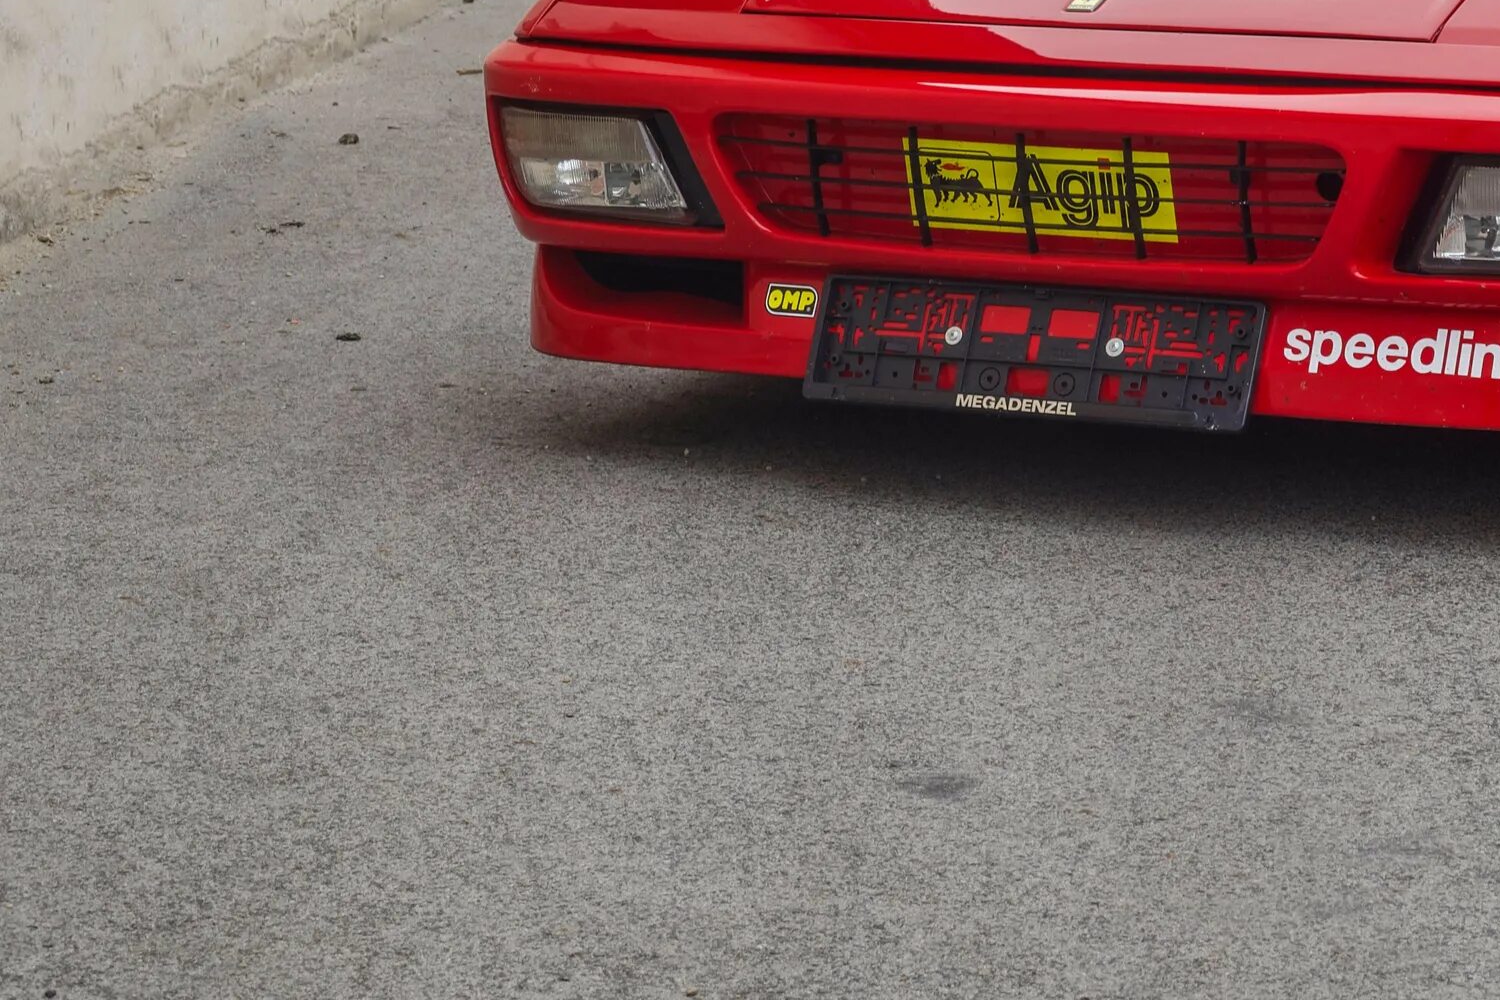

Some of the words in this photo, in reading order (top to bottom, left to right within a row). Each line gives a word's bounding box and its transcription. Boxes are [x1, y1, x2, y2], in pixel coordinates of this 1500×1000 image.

[1009, 153, 1160, 231] Agip
[768, 289, 815, 311] OMP
[955, 394, 1077, 416] MEGADENZEL
